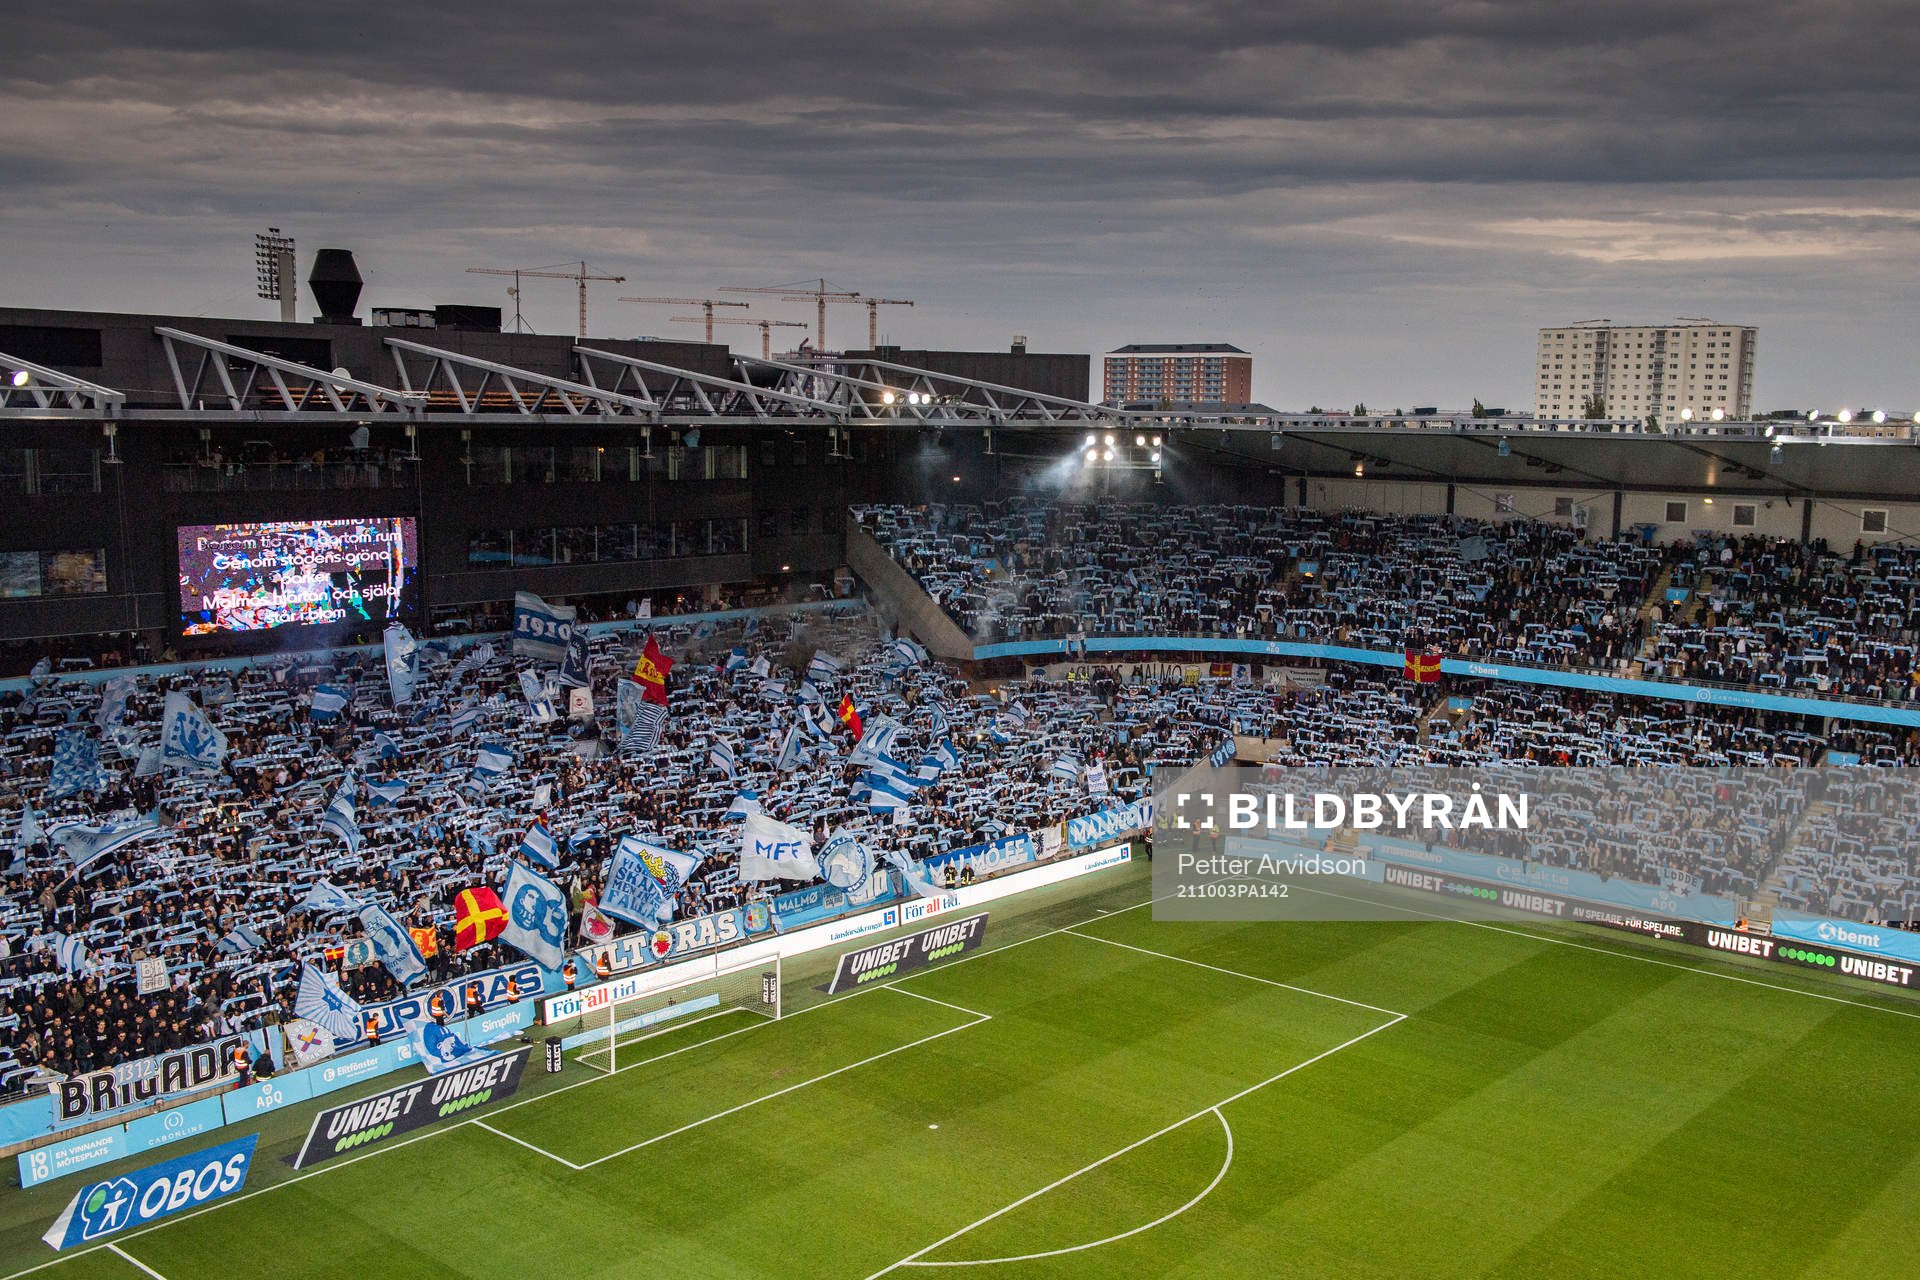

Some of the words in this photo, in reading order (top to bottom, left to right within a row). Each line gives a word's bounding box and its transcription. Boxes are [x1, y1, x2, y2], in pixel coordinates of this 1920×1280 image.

[376, 532, 401, 542] rum
[213, 555, 276, 570] Genom
[346, 549, 389, 566] gröna
[332, 587, 359, 599] och
[362, 583, 401, 601] själar
[518, 614, 570, 640] 1910
[1386, 868, 1443, 892] UNIBET
[905, 904, 924, 919] För
[926, 898, 940, 913] all
[1502, 890, 1565, 916] UNIBET
[1572, 906, 1584, 917] AV
[1585, 909, 1624, 926] SPELARE,
[1625, 916, 1641, 929] FÖR
[922, 918, 980, 957] UNIBET
[1707, 930, 1774, 957] UNIBET
[1838, 929, 1881, 948] bemt
[851, 938, 914, 974] UNIBET
[1840, 956, 1913, 985] UNIBET
[552, 998, 582, 1018] För
[587, 988, 609, 1009] all
[612, 980, 636, 998] tid
[482, 1011, 521, 1033] Simplify
[554, 1044, 562, 1072] SELECT
[117, 1058, 151, 1083] 1312
[432, 1055, 518, 1103] UNIBET
[256, 1090, 283, 1109] ApQ
[326, 1085, 423, 1140] UNIBET
[148, 1124, 203, 1146] CABONLINE
[55, 1150, 68, 1160] EN
[69, 1136, 113, 1155] VINNANDE
[56, 1147, 109, 1169] MÖTESPLATS
[140, 1153, 245, 1218] OBOS
